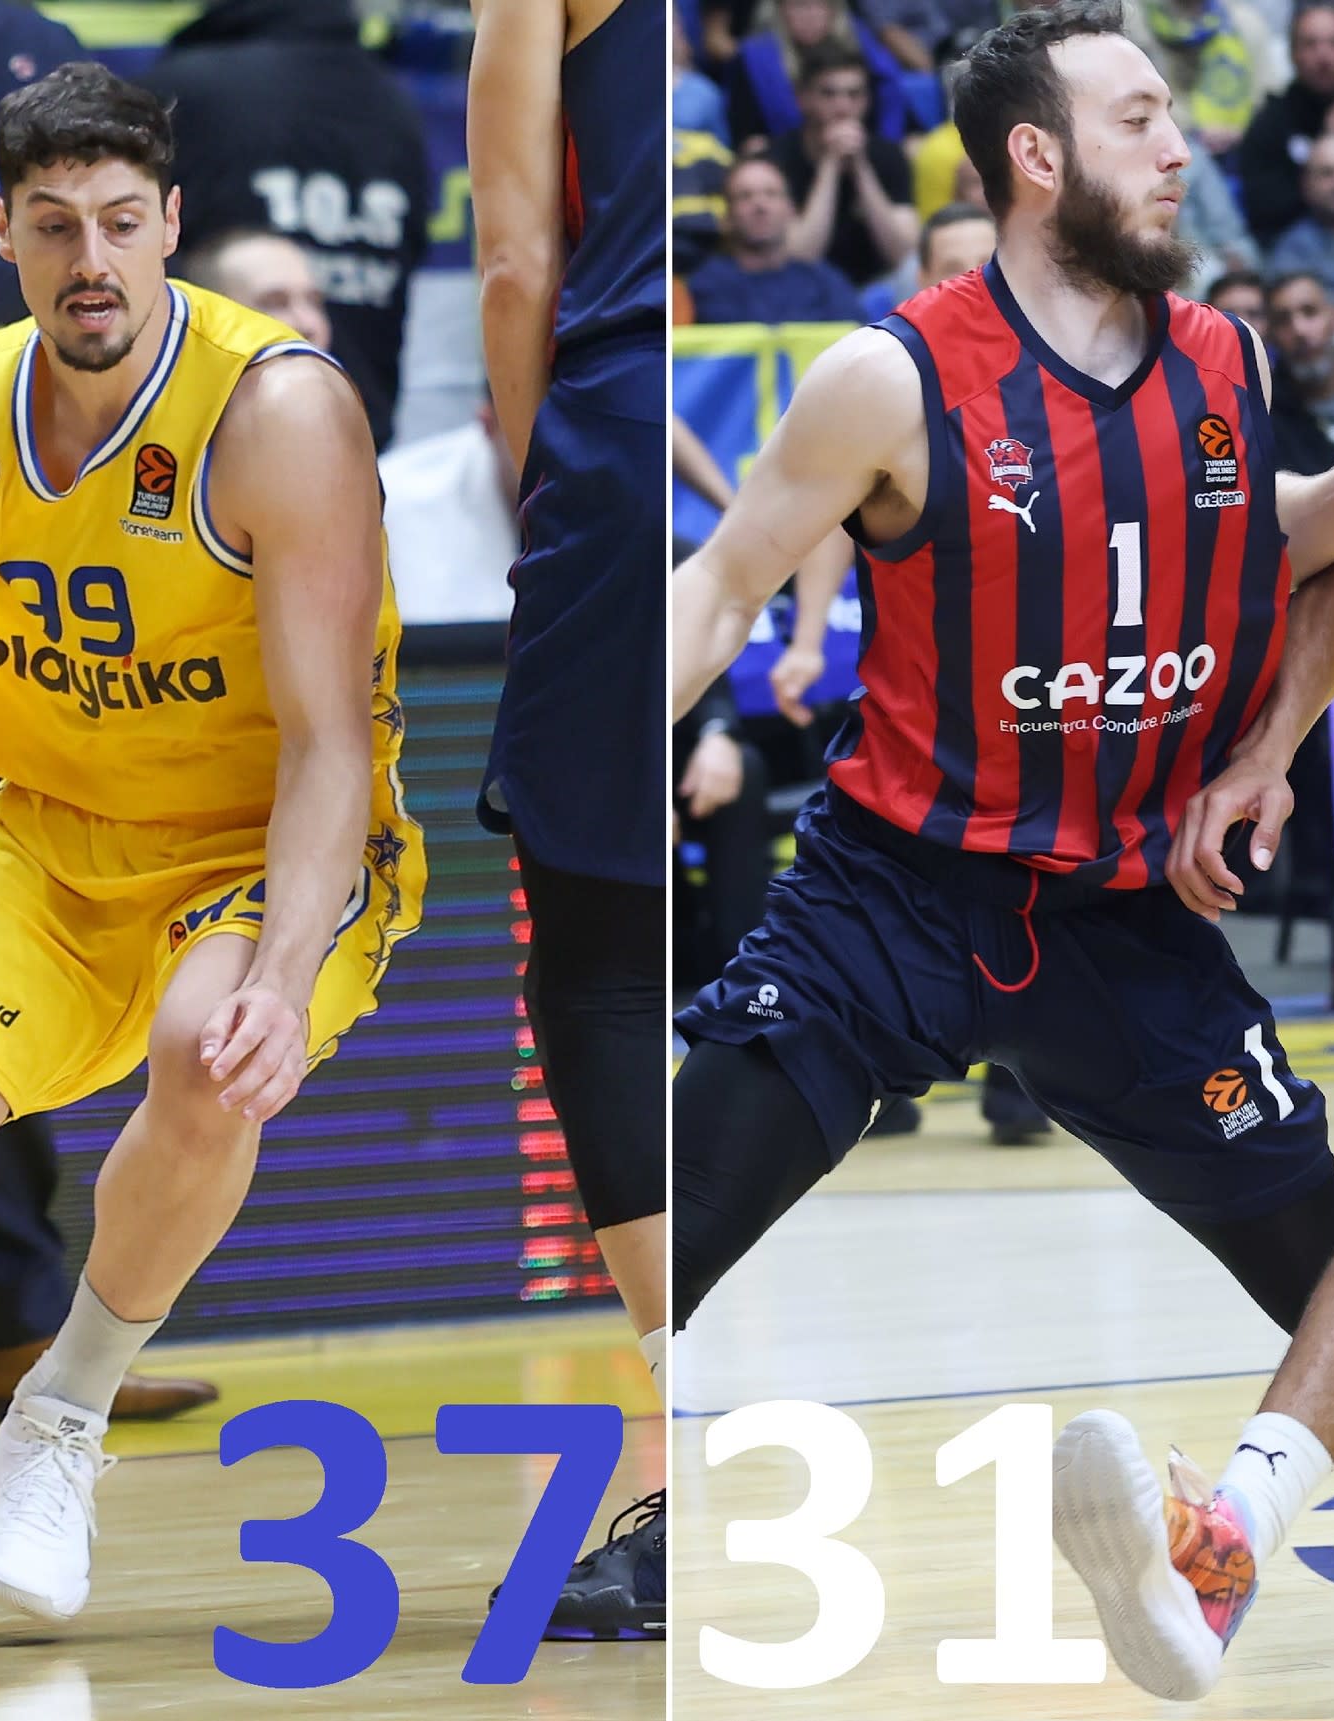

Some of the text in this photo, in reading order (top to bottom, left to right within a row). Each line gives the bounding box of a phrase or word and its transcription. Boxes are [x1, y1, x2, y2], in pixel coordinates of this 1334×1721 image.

[1204, 459, 1236, 467] TURKISH
[1108, 521, 1143, 627] 1
[999, 718, 1089, 734] Encuentra.
[1092, 714, 1158, 734] Conduce.
[1244, 1022, 1295, 1121] 1
[1218, 1100, 1258, 1123] TURKISH
[1222, 1107, 1261, 1132] AIRLINES
